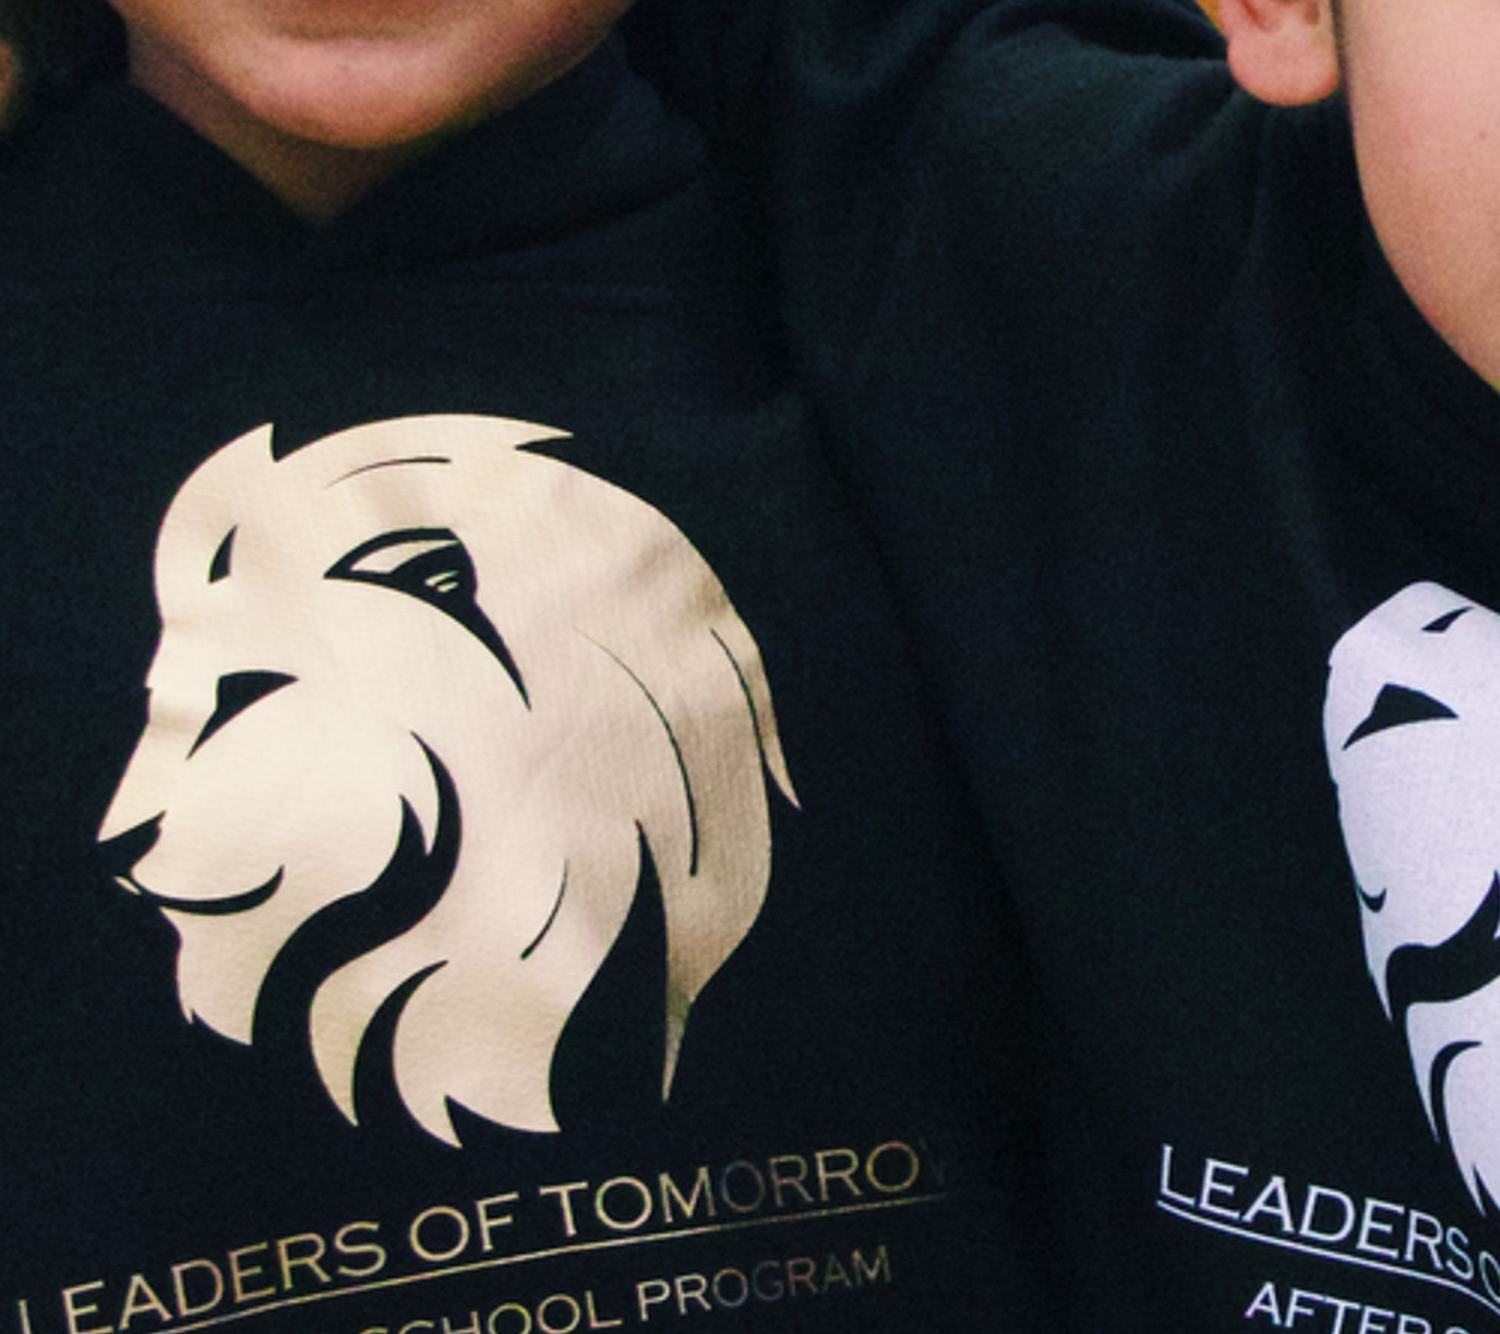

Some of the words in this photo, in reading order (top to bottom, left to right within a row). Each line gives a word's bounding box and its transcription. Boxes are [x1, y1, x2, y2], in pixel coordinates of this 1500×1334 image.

[408, 1191, 520, 1262] OF
[1159, 1143, 1476, 1280] LEADERS
[635, 1244, 894, 1322] PROGRAM
